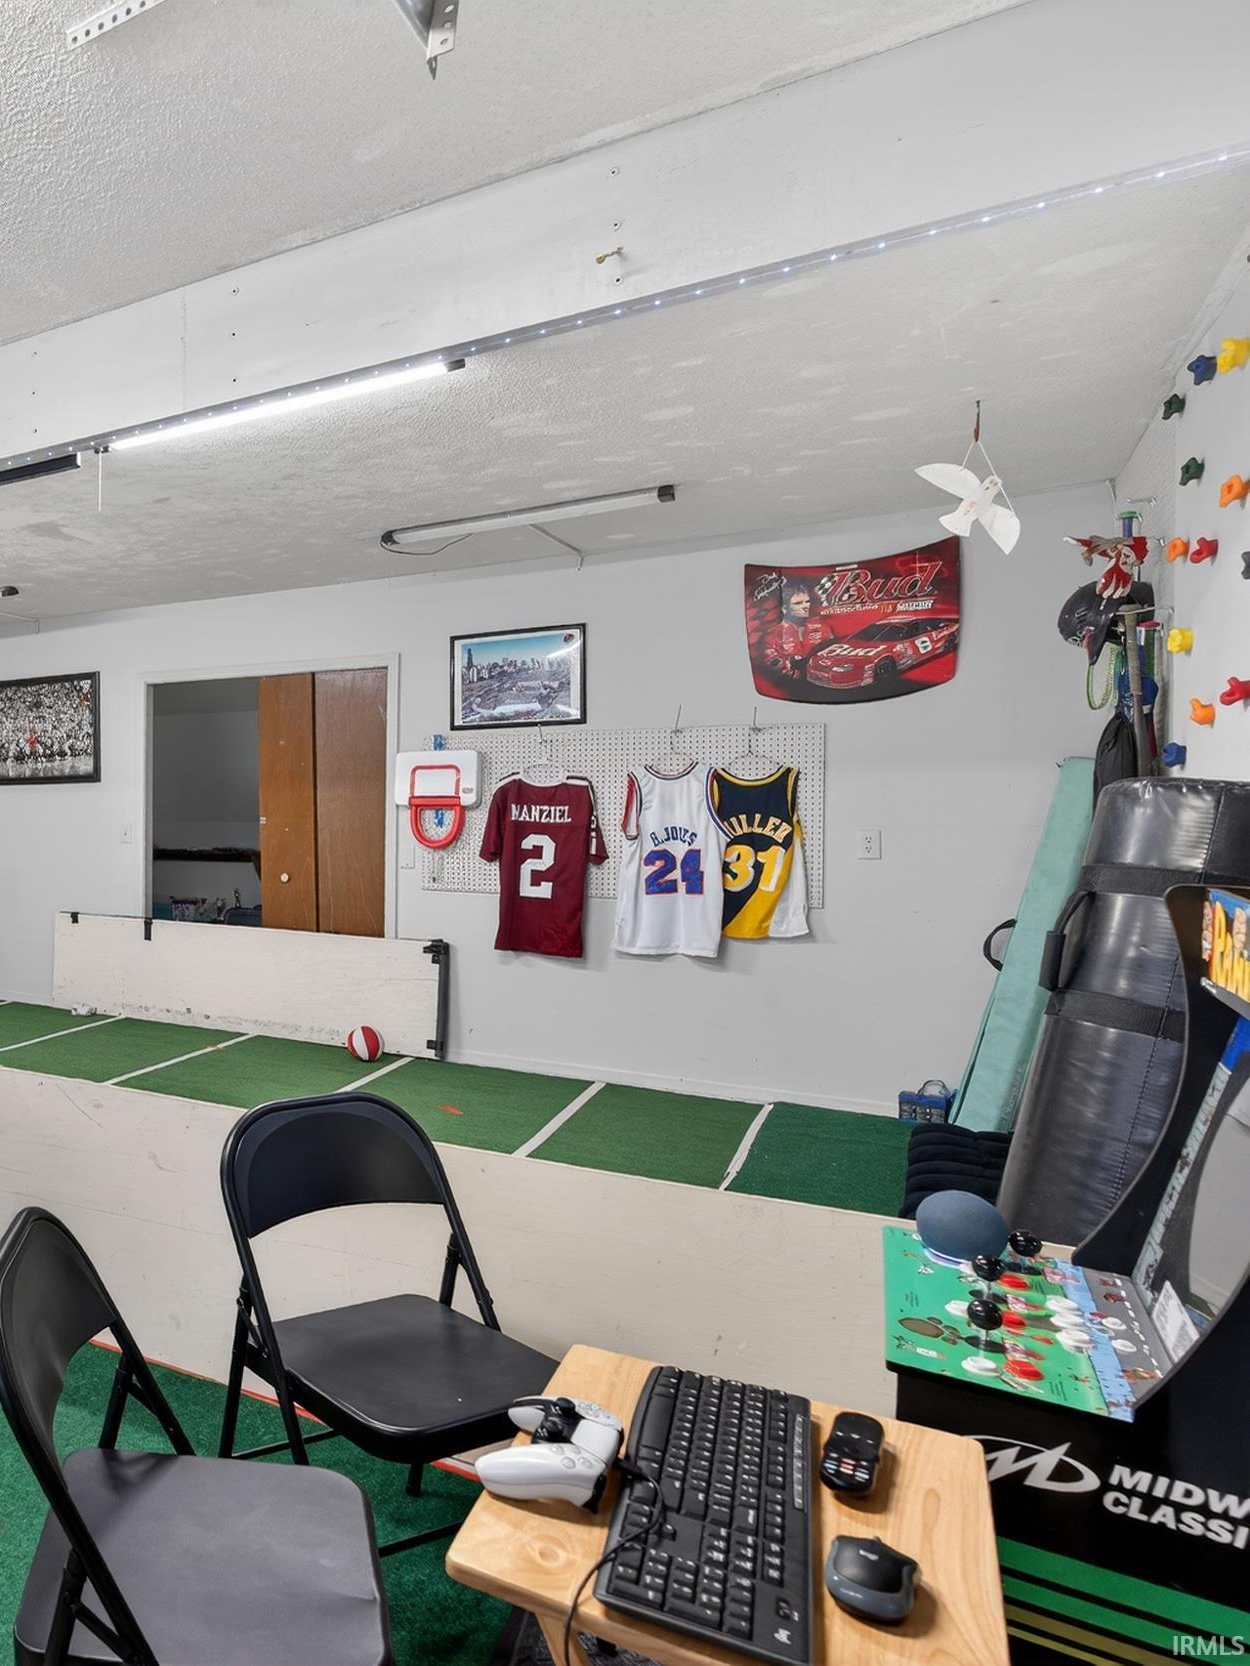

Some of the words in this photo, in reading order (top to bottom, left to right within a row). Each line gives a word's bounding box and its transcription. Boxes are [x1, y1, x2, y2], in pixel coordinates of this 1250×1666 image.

[826, 561, 942, 604] Bud
[519, 833, 556, 898] 2
[643, 848, 704, 895] 24
[723, 844, 786, 892] 31
[1109, 1464, 1250, 1519] MIDW
[1102, 1491, 1250, 1549] CLASSI
